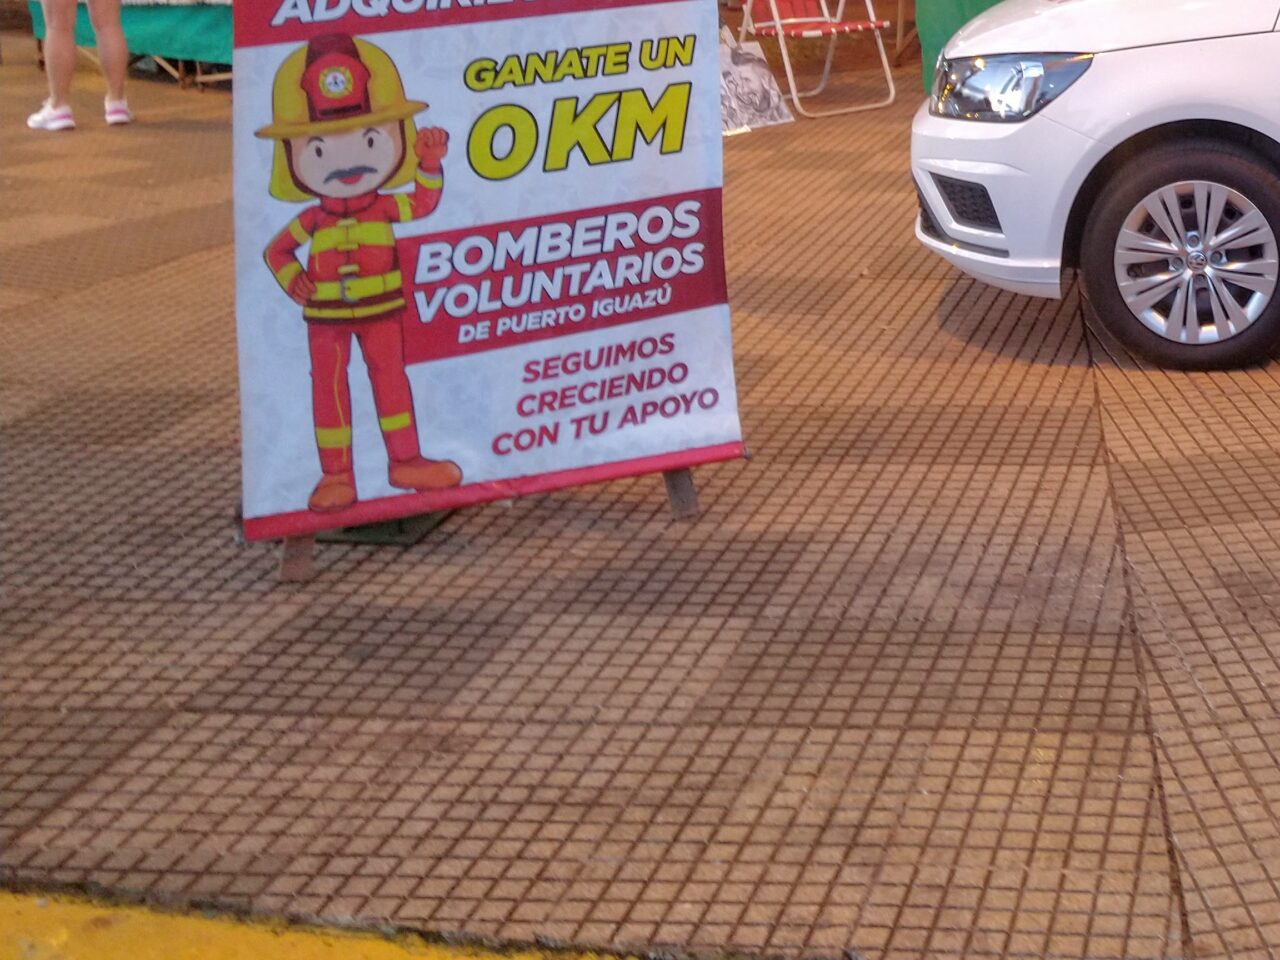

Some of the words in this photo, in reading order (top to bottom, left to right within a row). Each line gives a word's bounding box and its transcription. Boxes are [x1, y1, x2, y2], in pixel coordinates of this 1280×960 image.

[463, 42, 631, 92] GANATE
[639, 35, 697, 70] UN
[413, 200, 701, 284] BOMBEROS
[413, 243, 705, 324] VOLUNTARIOS
[458, 322, 490, 344] DE
[496, 305, 586, 337] PUERTO
[592, 283, 673, 319] IGUAZÚ
[522, 332, 676, 383] SEGUIMOS
[515, 362, 689, 418] CRECIENDO
[491, 424, 563, 456] CON
[570, 414, 610, 440] TU
[618, 386, 719, 431] APOYO
